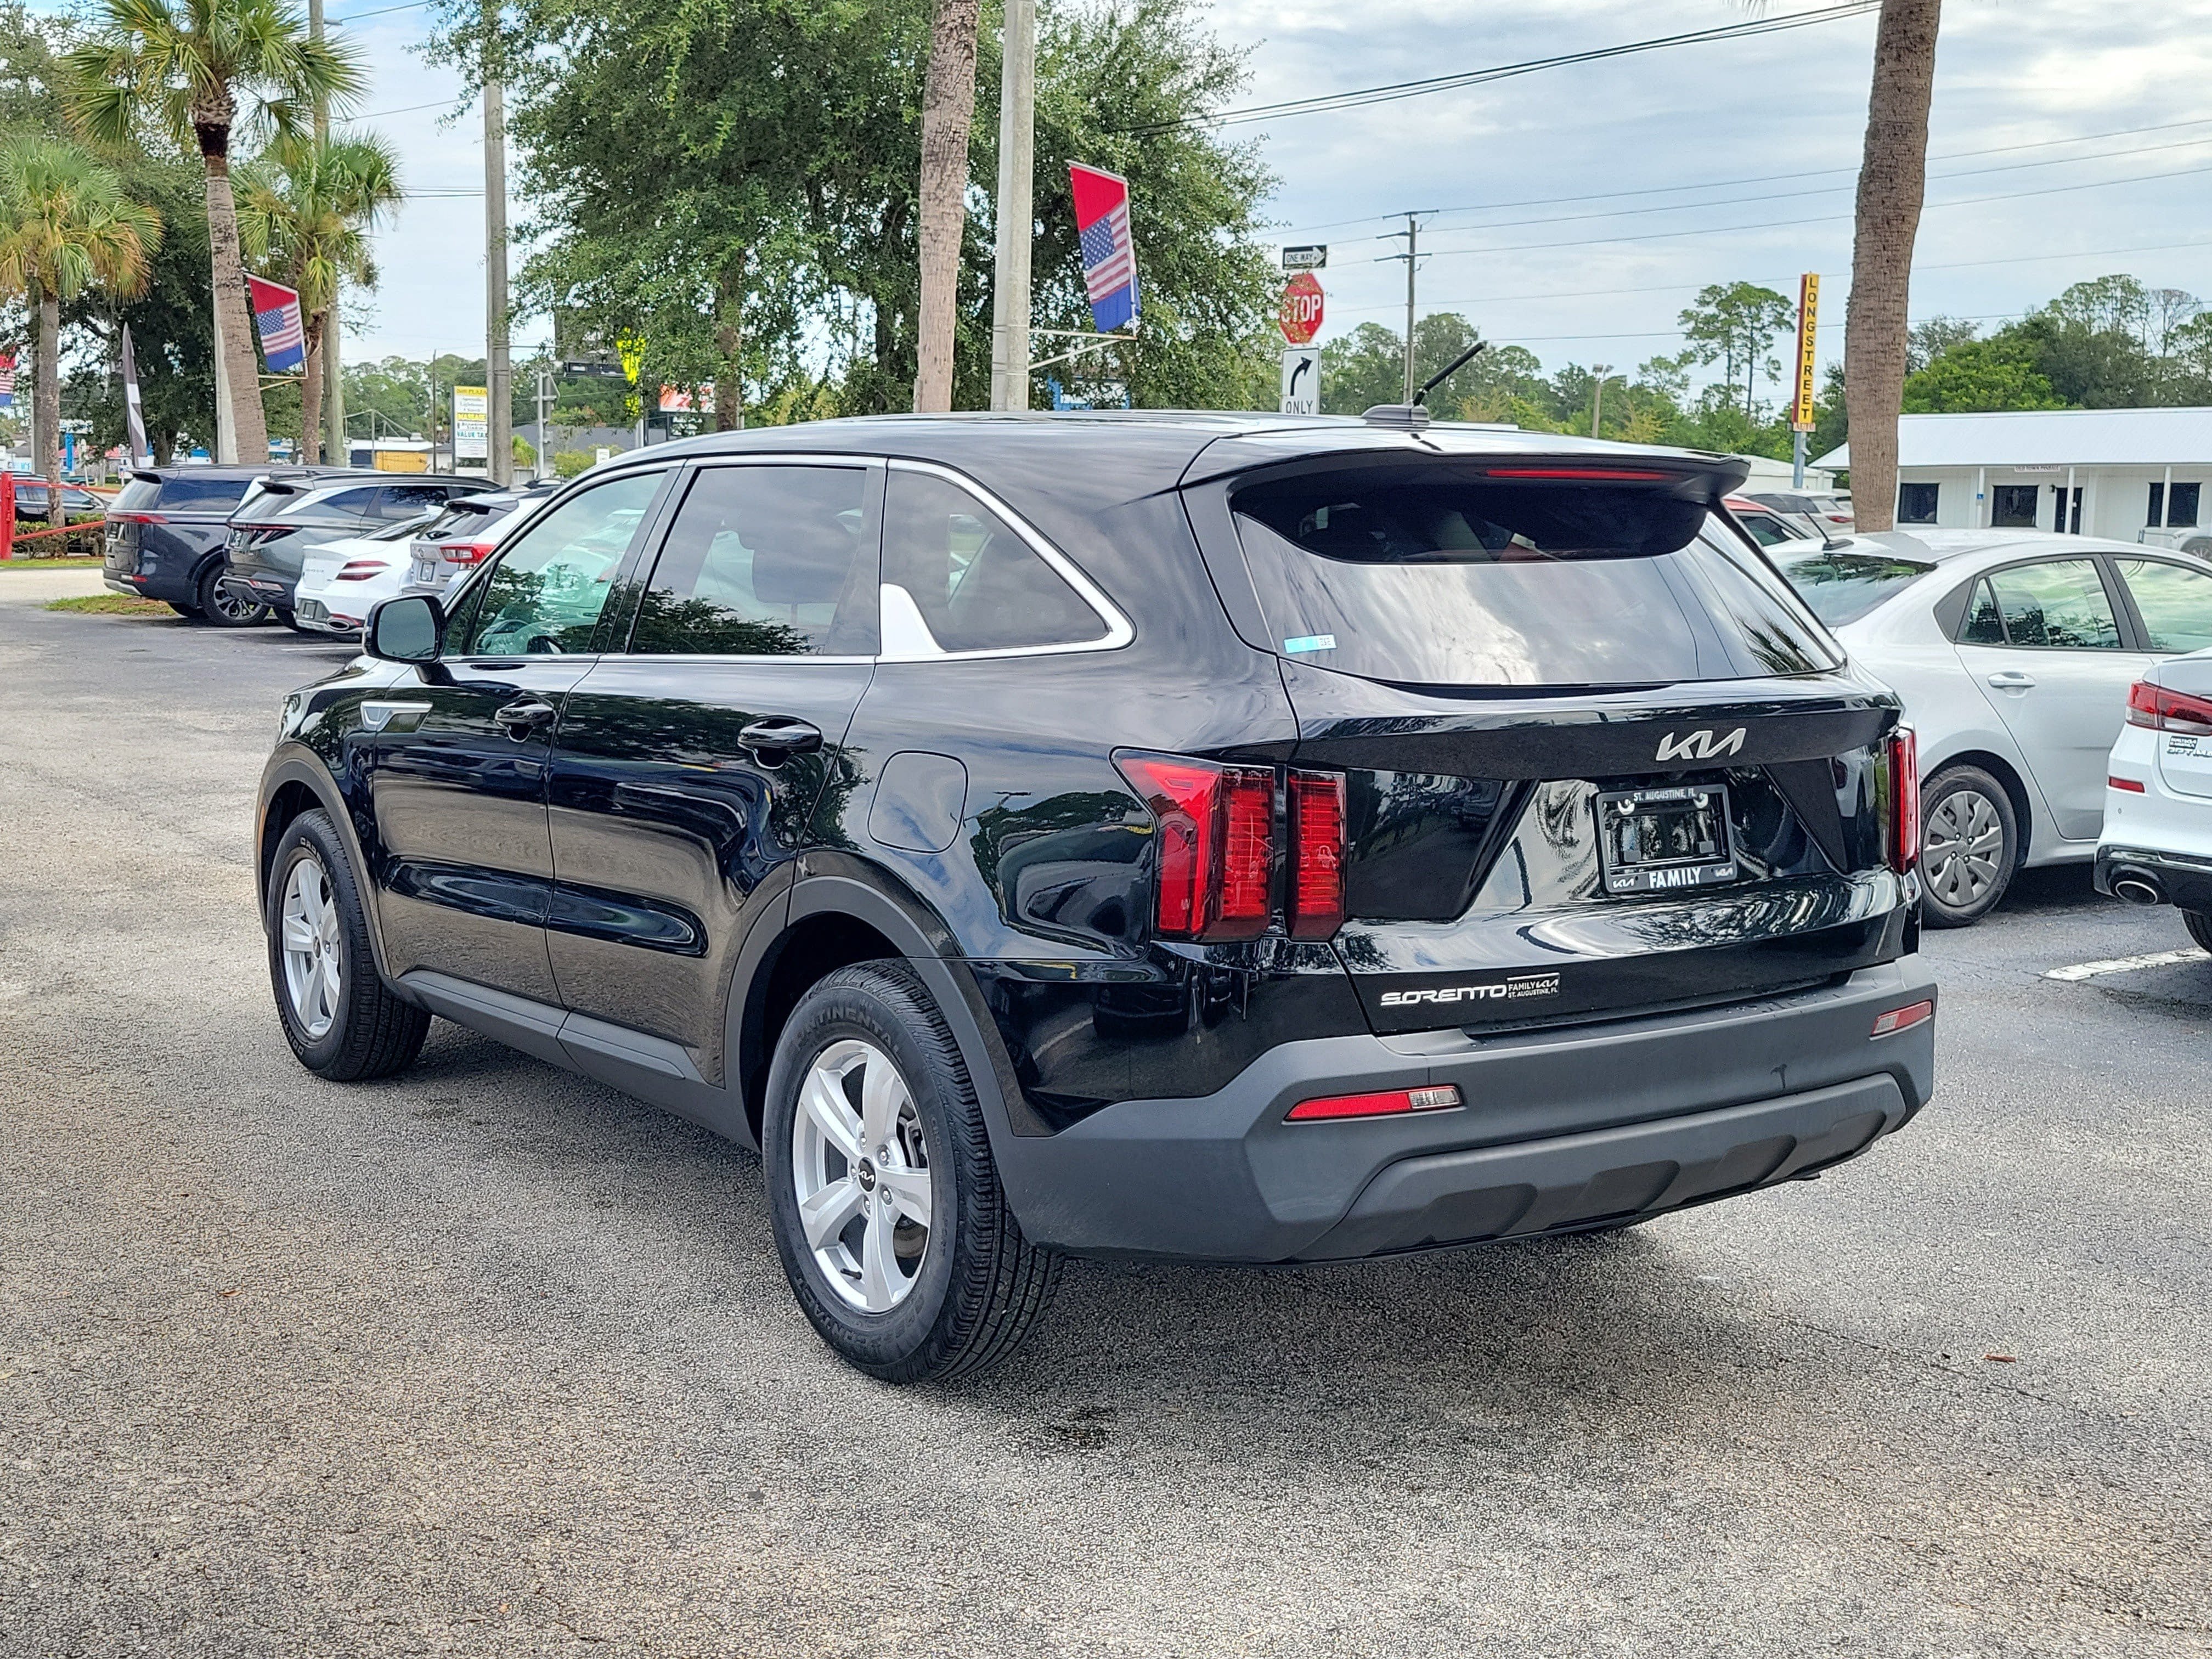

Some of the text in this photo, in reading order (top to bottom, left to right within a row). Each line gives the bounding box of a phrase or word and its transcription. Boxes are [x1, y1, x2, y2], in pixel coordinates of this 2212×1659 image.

[1286, 253, 1314, 263] ONE WAY
[1281, 294, 1322, 323] STOP
[1801, 276, 1817, 420] LONGSTREET
[1285, 400, 1313, 414] ONLY
[1633, 792, 1644, 802] ST.
[1688, 788, 1696, 797] FL
[1649, 867, 1701, 889] FAMILY
[1380, 984, 1507, 1006] SORENTO
[1508, 981, 1536, 991] FAMILY
